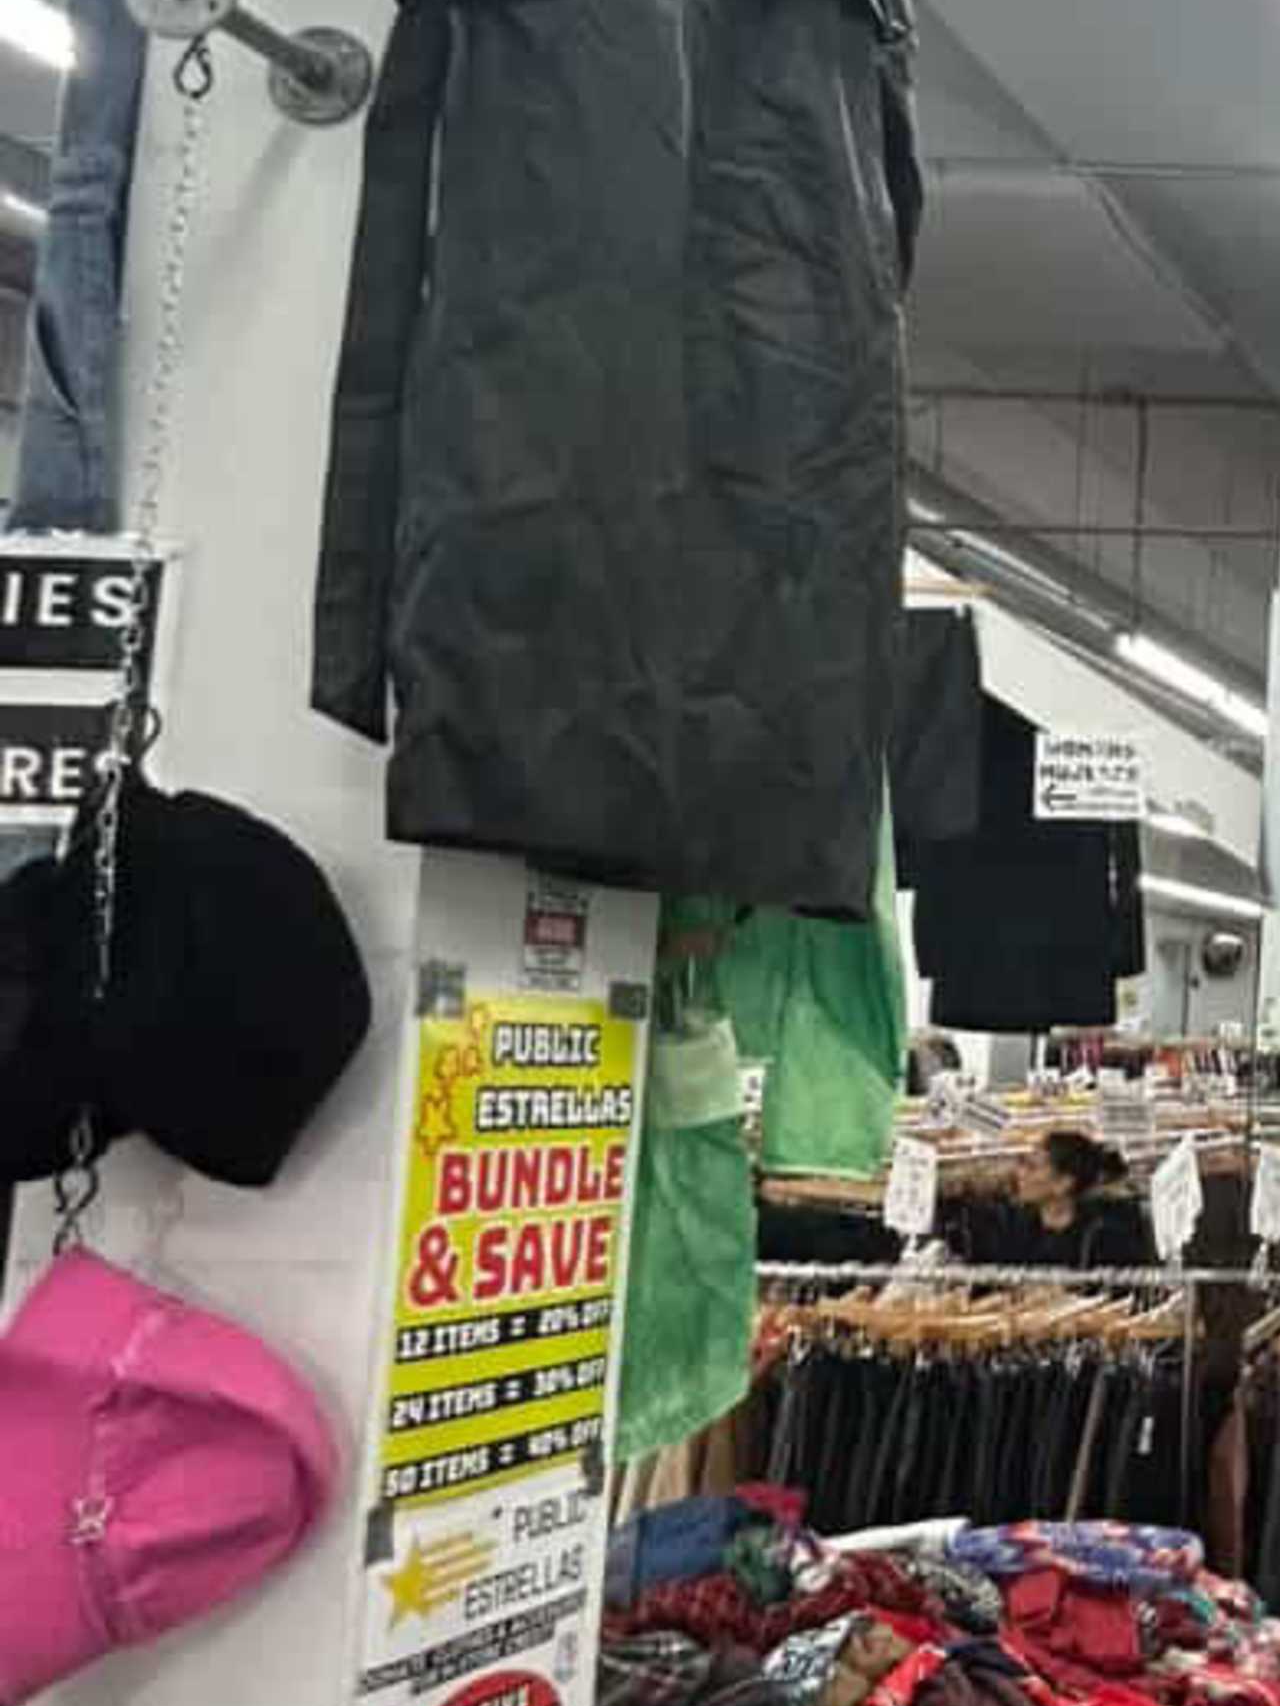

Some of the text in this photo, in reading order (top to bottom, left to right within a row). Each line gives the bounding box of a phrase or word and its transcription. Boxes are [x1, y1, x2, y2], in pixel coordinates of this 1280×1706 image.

[491, 1023, 601, 1067] PUBLIC
[475, 1086, 632, 1132] ESTRELLAS
[438, 1144, 627, 1215] BUNDLE
[408, 1217, 612, 1307] & SAVE
[400, 1330, 428, 1358] 12
[433, 1318, 499, 1353] ITEMS
[511, 1315, 526, 1336] =
[429, 1381, 497, 1421] ITEMS
[505, 1380, 521, 1401] =
[420, 1446, 489, 1488] ITEMS
[500, 1443, 516, 1463] =
[464, 1543, 583, 1620] ESTRELLAS
